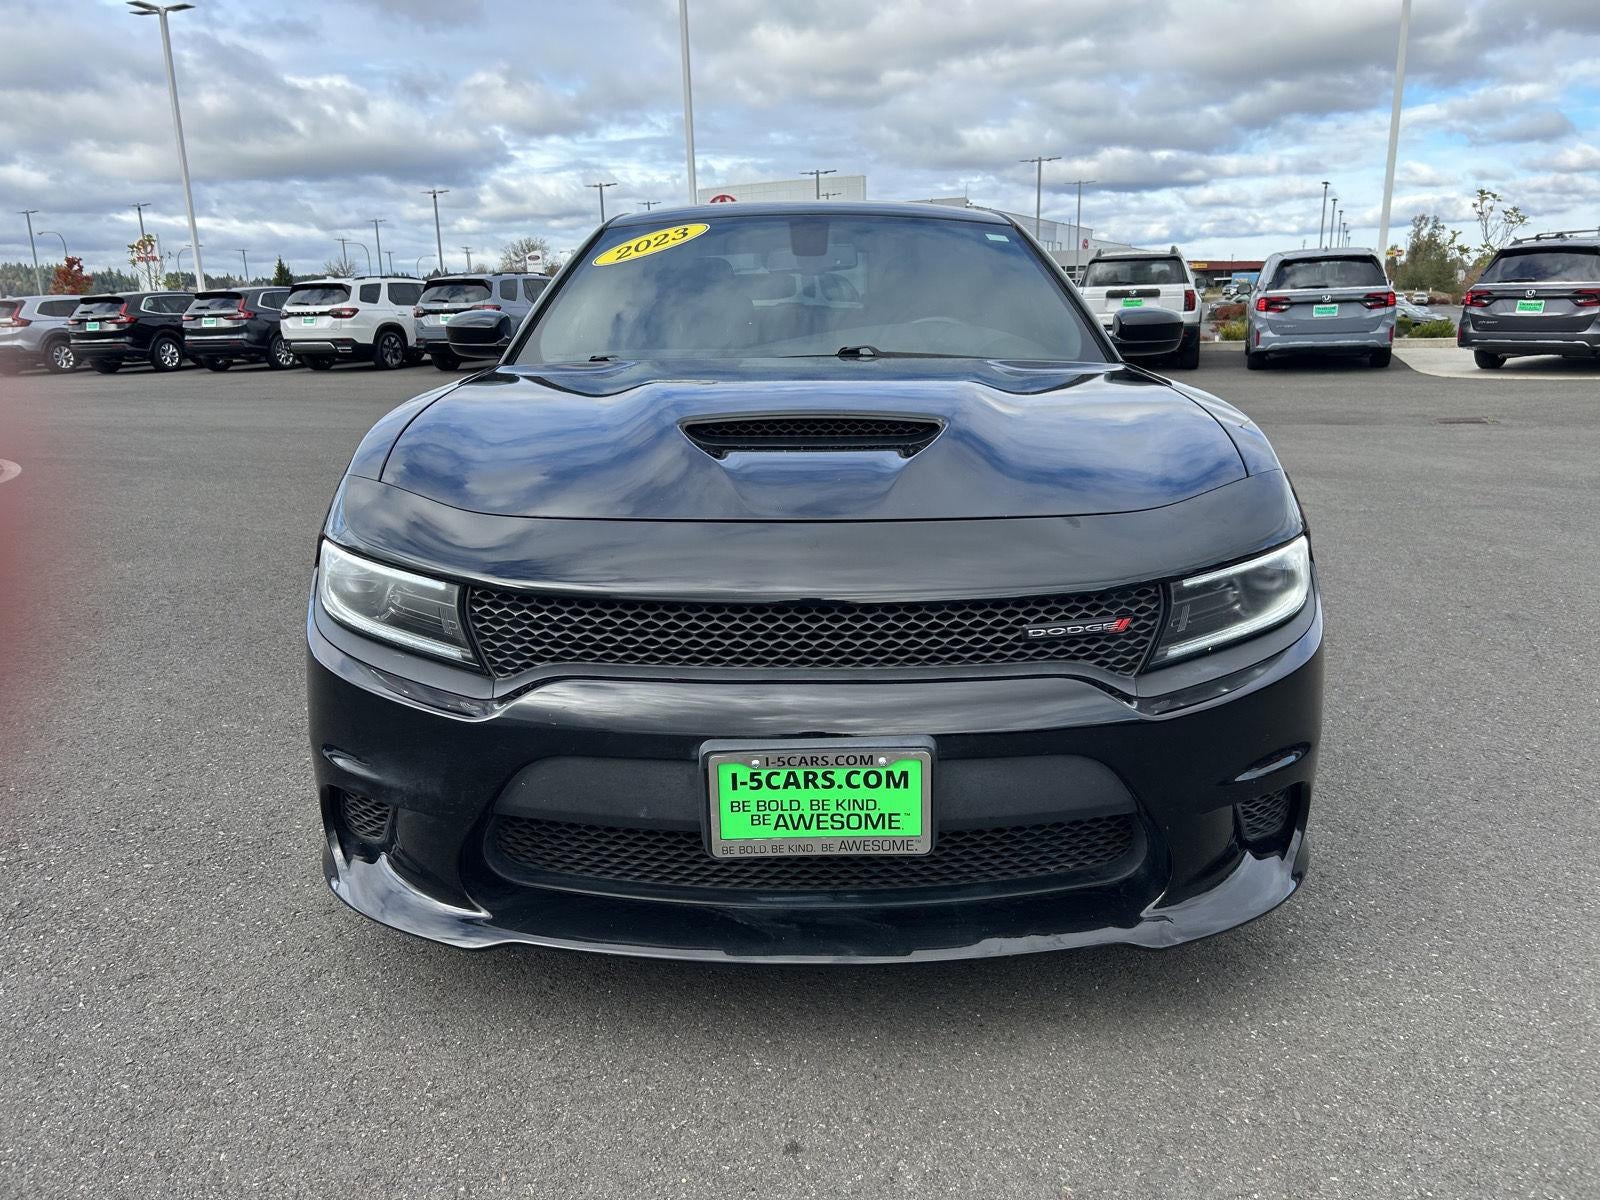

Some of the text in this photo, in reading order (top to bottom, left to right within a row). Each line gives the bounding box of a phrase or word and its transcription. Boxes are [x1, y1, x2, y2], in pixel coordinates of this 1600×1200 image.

[615, 227, 689, 261] 2023
[1028, 622, 1119, 636] DODGE
[765, 754, 874, 767] I-5CARS.COM
[730, 770, 909, 791] I-5CARS.COM
[730, 798, 881, 812] BE BOLD. BE KIND.
[750, 814, 771, 826] BE
[721, 846, 735, 855] BE
[739, 845, 769, 854] BOLD.
[771, 844, 784, 853] BE
[788, 843, 815, 853] KIND.
[821, 843, 834, 852] BE
